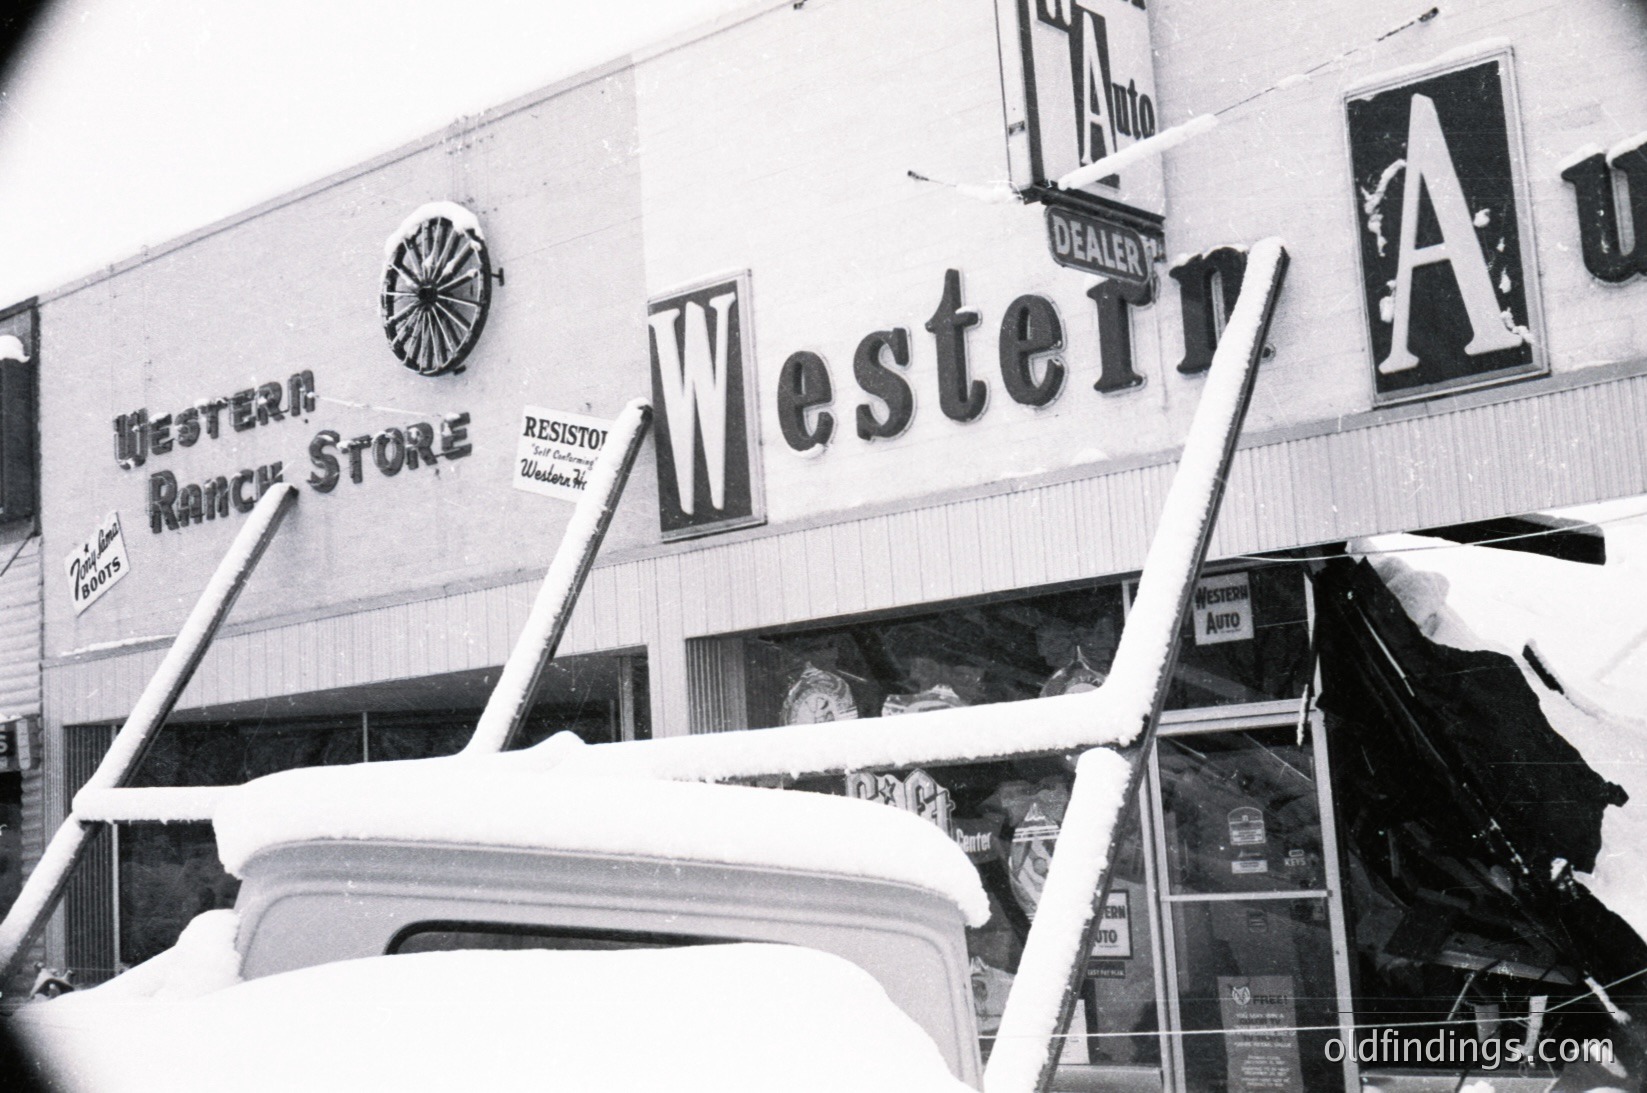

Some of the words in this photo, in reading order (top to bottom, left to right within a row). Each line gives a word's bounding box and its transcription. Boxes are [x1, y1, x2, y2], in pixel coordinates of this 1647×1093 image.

[1082, 11, 1156, 165] Auto
[1052, 213, 1144, 277] DEALER
[649, 247, 1274, 515] Western
[113, 370, 315, 470] WESTERN
[307, 412, 472, 494] STORE
[521, 458, 571, 488] Western
[70, 547, 97, 601] Tony
[81, 556, 121, 600] BOOTS
[1196, 585, 1249, 610] WESTERN
[1206, 611, 1240, 635] AUTO
[1284, 857, 1306, 868] KEYS
[1253, 995, 1288, 1005] FREE!
